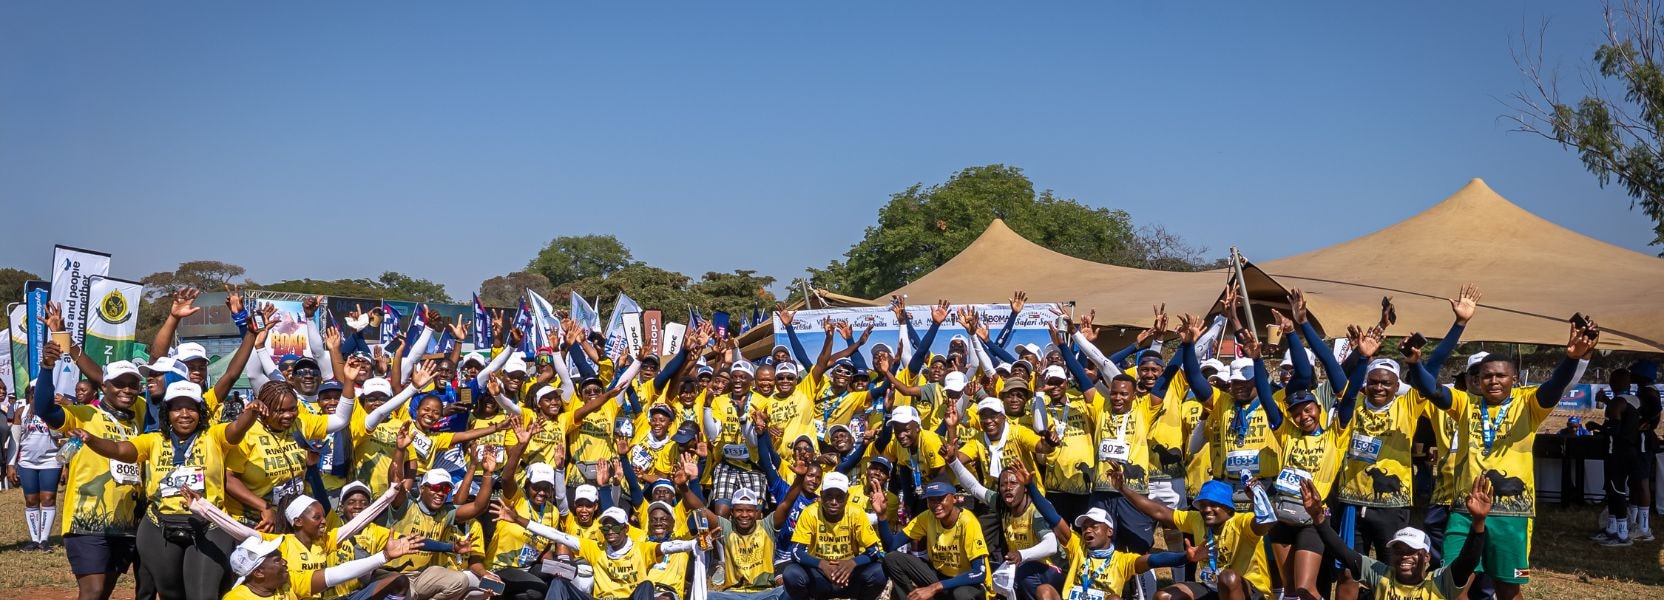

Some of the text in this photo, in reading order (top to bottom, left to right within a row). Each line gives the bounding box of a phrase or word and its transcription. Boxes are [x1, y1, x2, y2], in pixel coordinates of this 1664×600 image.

[68, 260, 80, 320] and people
[78, 274, 90, 320] together
[1015, 318, 1049, 327] Safari Sp
[605, 332, 616, 356] NET
[1353, 440, 1374, 453] 1596
[1230, 456, 1254, 466] 1635
[166, 474, 198, 487] 873
[816, 543, 850, 554] HEAR
[302, 562, 318, 570] RUN
